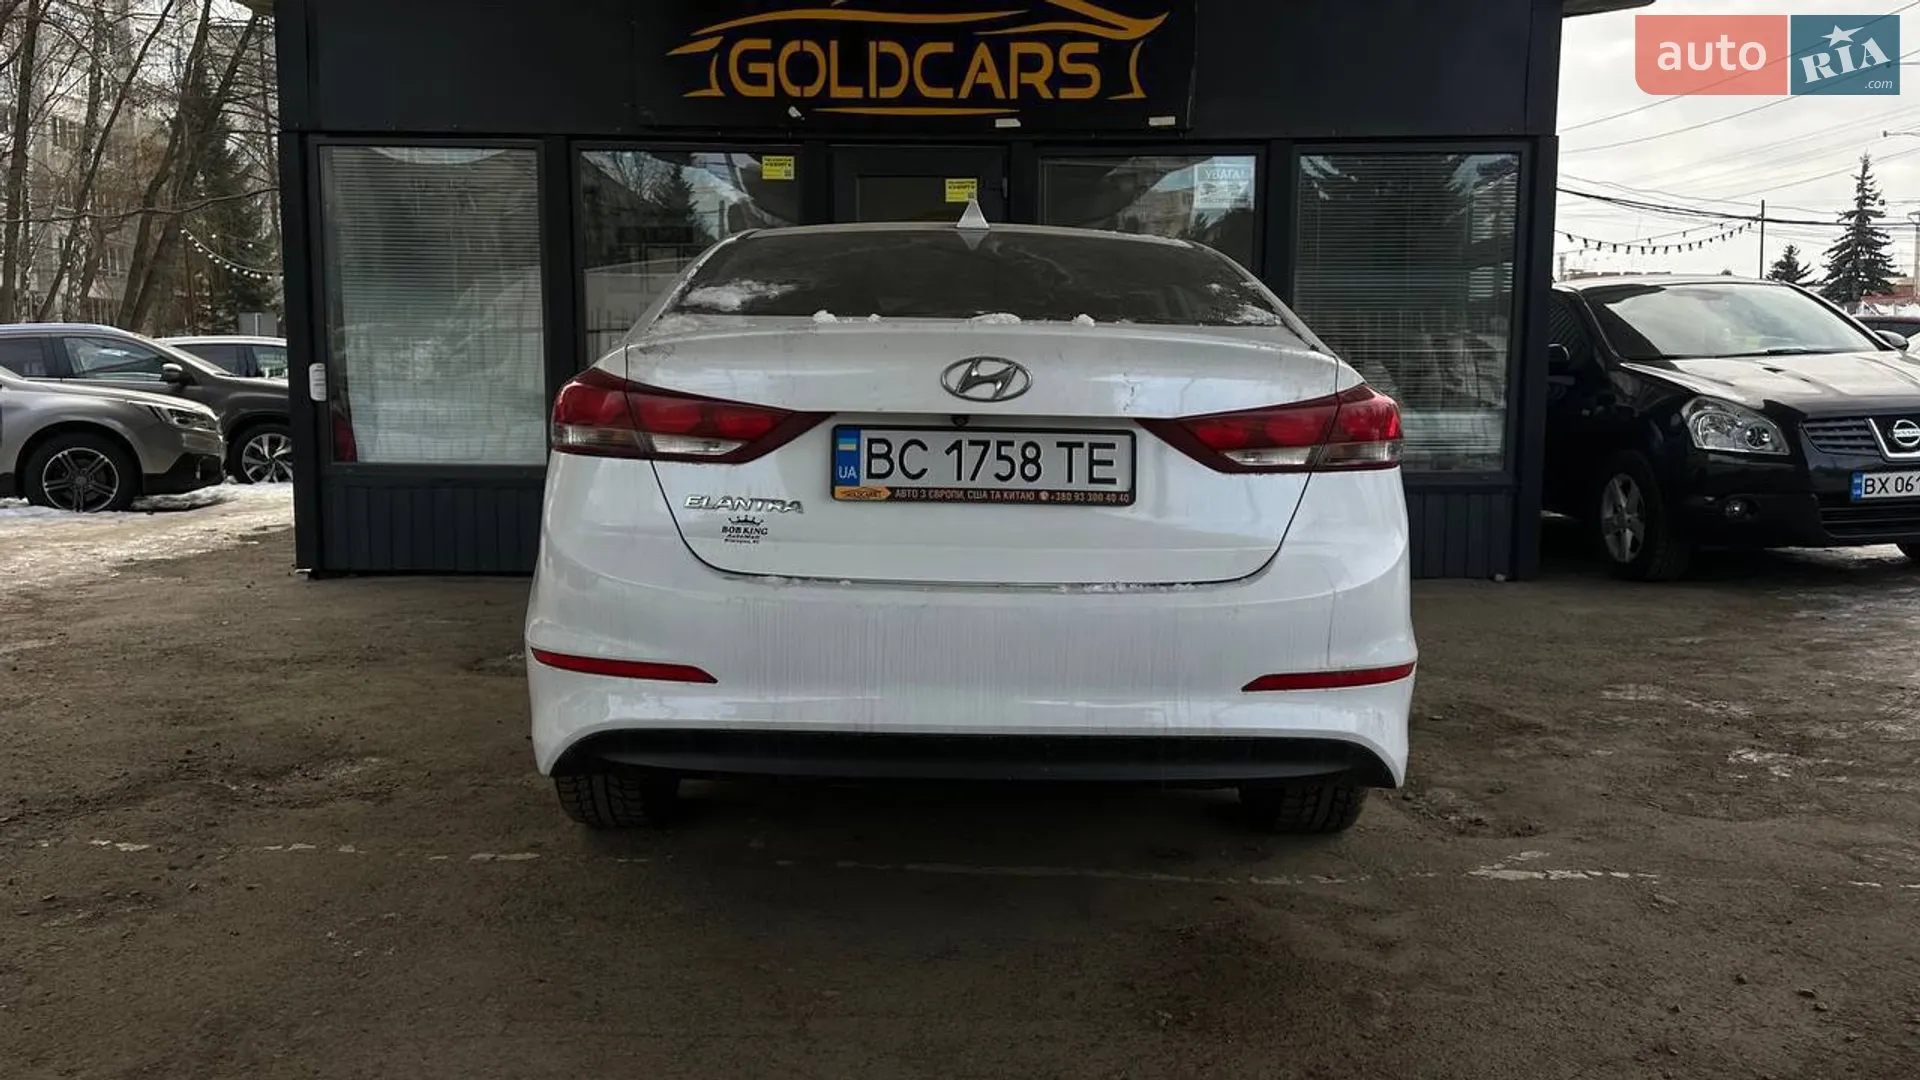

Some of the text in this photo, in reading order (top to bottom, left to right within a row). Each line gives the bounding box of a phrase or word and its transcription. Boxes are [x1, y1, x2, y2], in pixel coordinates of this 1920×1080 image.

[728, 38, 1101, 99] GOLDCARS
[866, 438, 1117, 485] BC 1758 TE
[839, 466, 857, 479] UA
[894, 489, 919, 499] АВТО
[967, 490, 988, 499] США
[991, 490, 1001, 499] ТА
[1003, 490, 1035, 500] КИТАЮ
[1864, 477, 1890, 495] BX
[683, 494, 804, 514] ELANTRA
[721, 526, 768, 535] BOB KING
